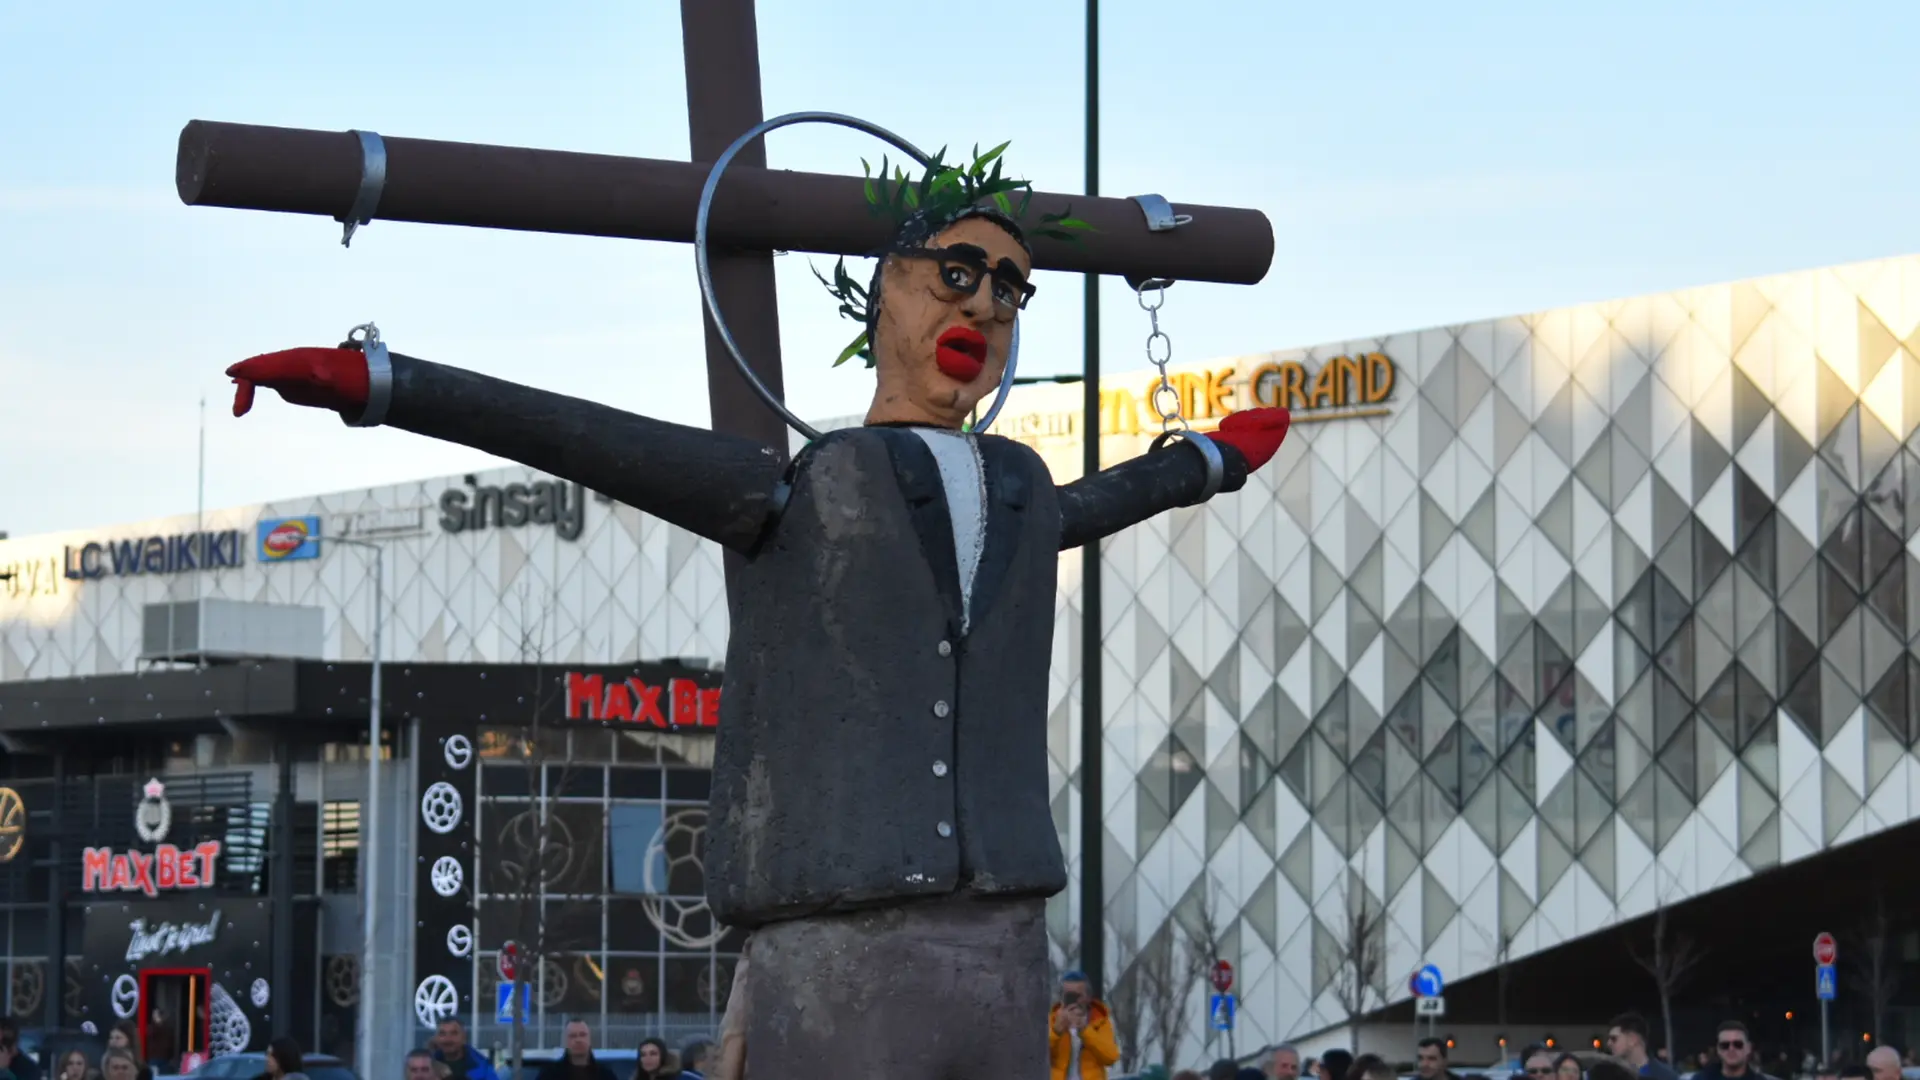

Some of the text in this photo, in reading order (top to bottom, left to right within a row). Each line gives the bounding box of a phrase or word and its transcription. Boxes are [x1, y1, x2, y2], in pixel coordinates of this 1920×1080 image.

[1144, 351, 1396, 422] CINE GRAND
[438, 473, 585, 543] sinsay
[64, 540, 106, 580] LC
[565, 670, 722, 728] MAXBE
